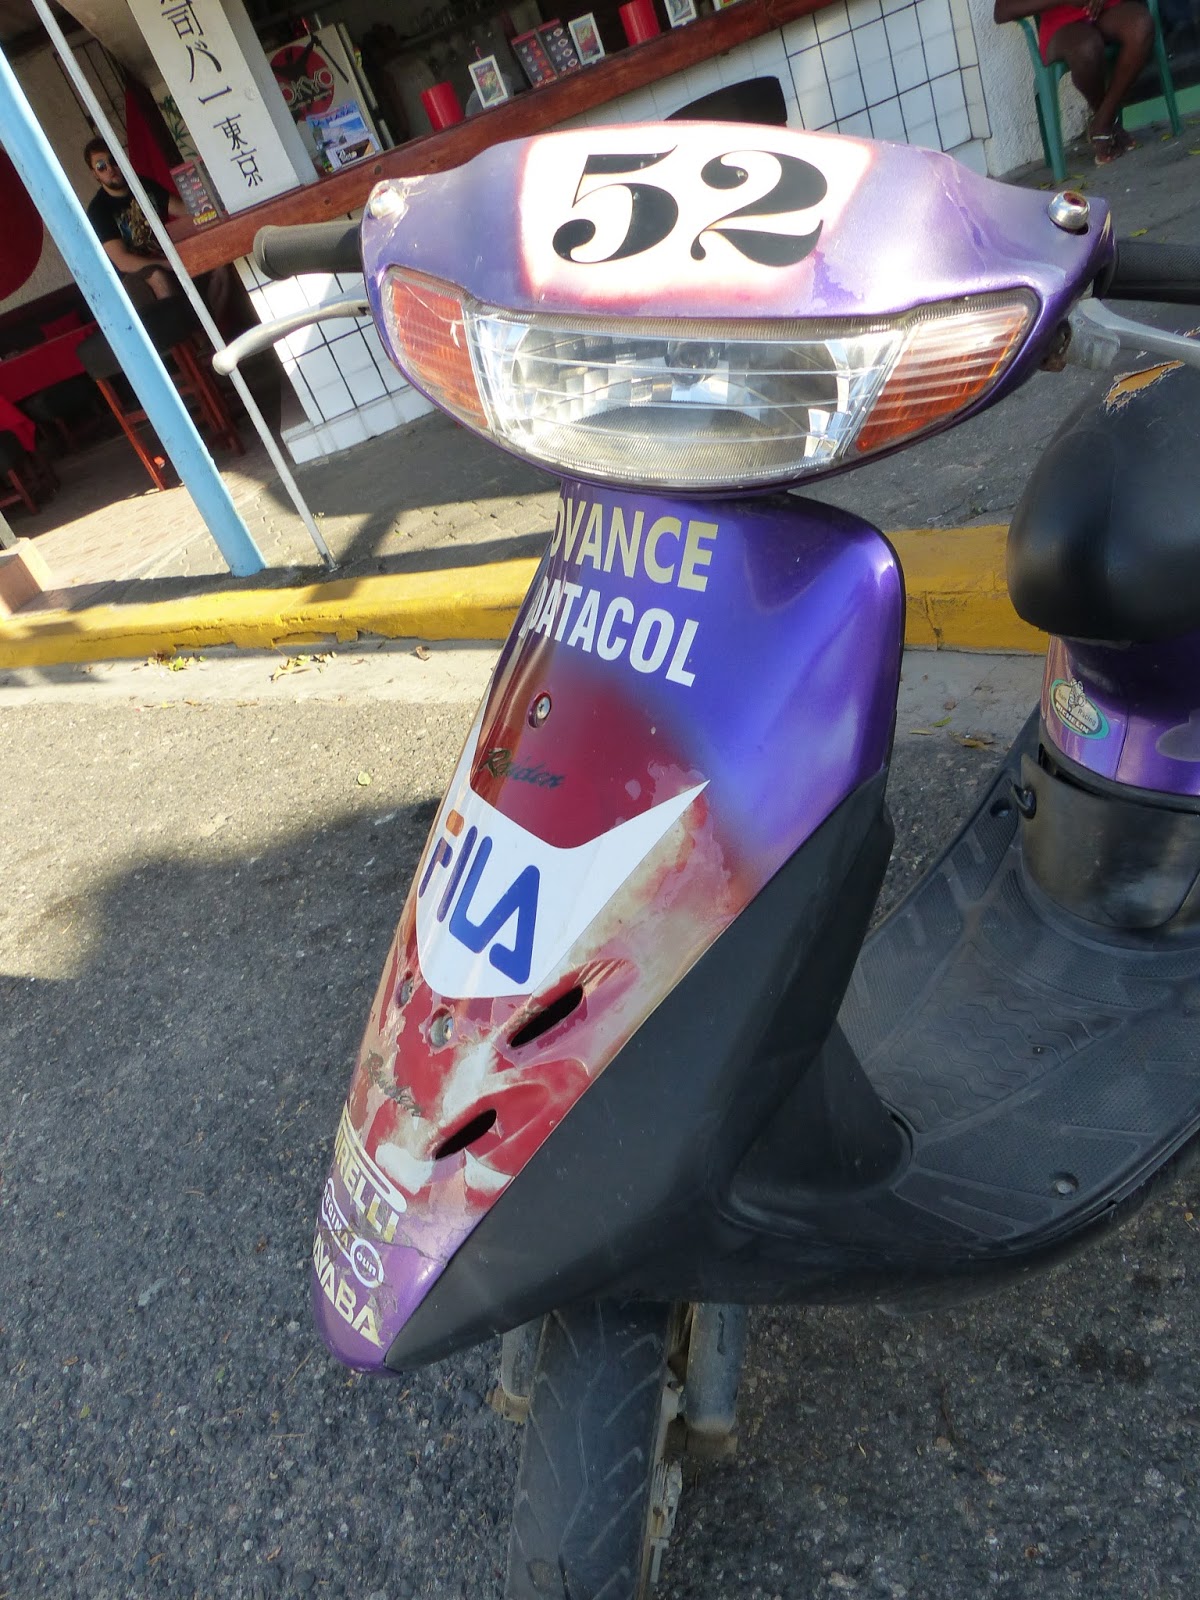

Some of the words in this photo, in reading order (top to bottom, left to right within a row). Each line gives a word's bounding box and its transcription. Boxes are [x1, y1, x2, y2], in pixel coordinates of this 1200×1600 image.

[160, 0, 264, 187] 司バー東京
[552, 144, 828, 268] 52
[518, 575, 699, 687] DATACOL
[418, 809, 541, 985] FILA
